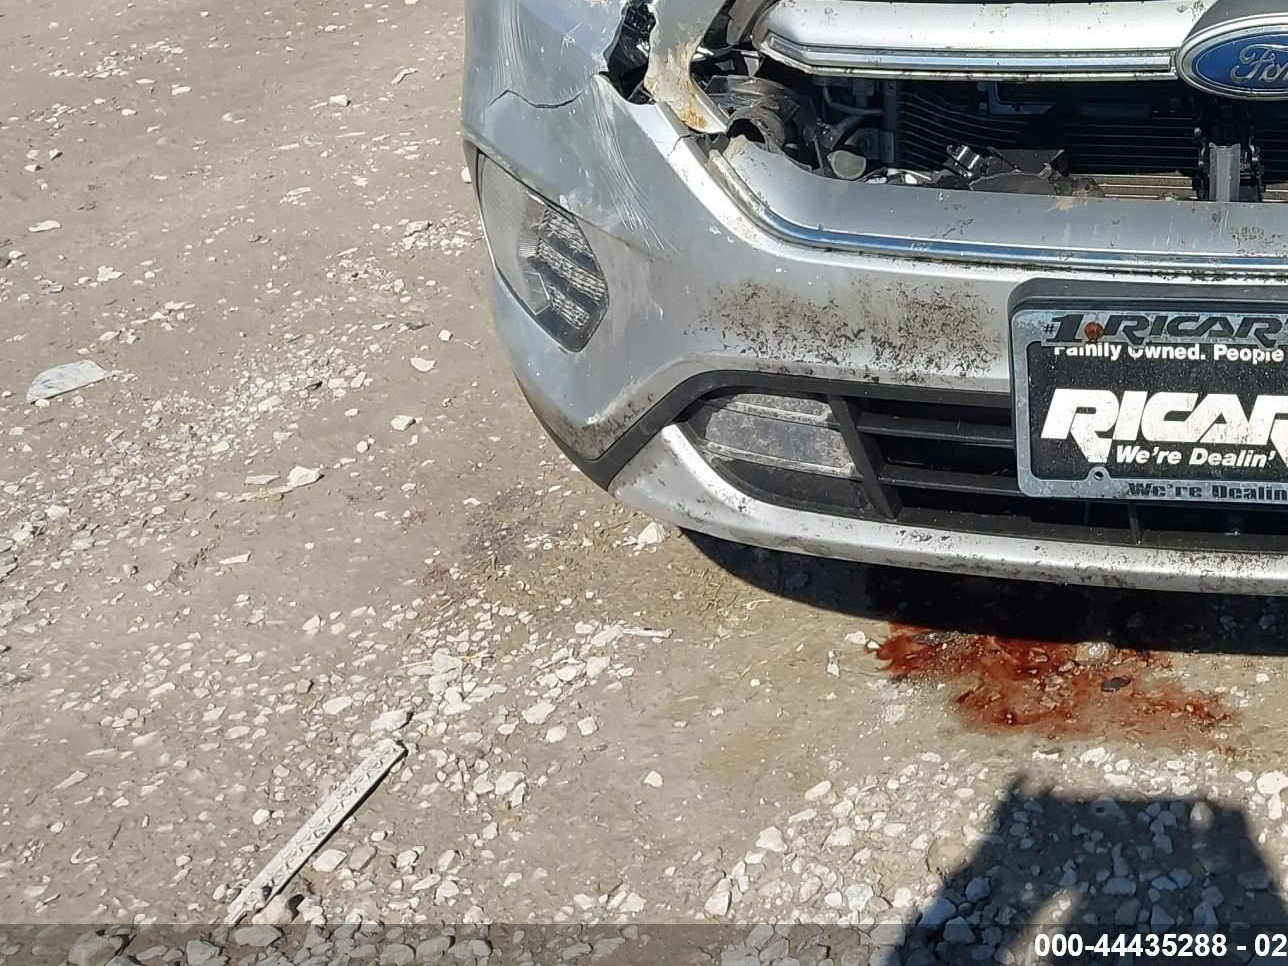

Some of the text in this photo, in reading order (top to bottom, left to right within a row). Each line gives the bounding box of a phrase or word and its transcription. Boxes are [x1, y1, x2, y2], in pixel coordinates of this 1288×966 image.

[1213, 344, 1285, 365] People
[1115, 445, 1274, 469] We're Dealin'
[1127, 481, 1202, 499] We're
